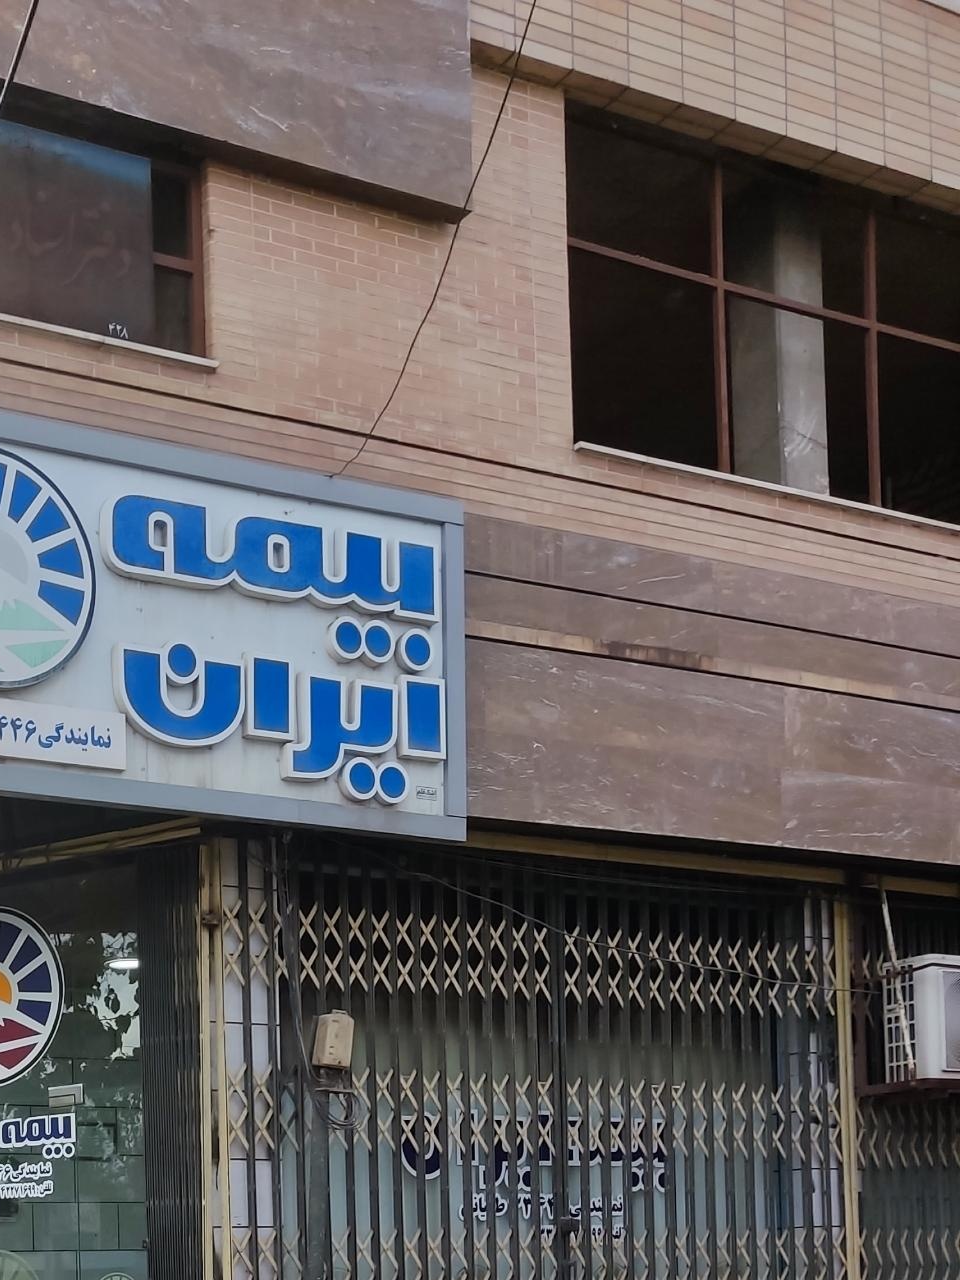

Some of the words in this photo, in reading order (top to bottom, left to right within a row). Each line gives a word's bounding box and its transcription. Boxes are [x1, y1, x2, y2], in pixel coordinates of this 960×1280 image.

[101, 493, 442, 672] بیمه
[38, 722, 112, 752] نمایندگی
[114, 640, 446, 805] ایران
[12, 1161, 53, 1182] نمایندگی
